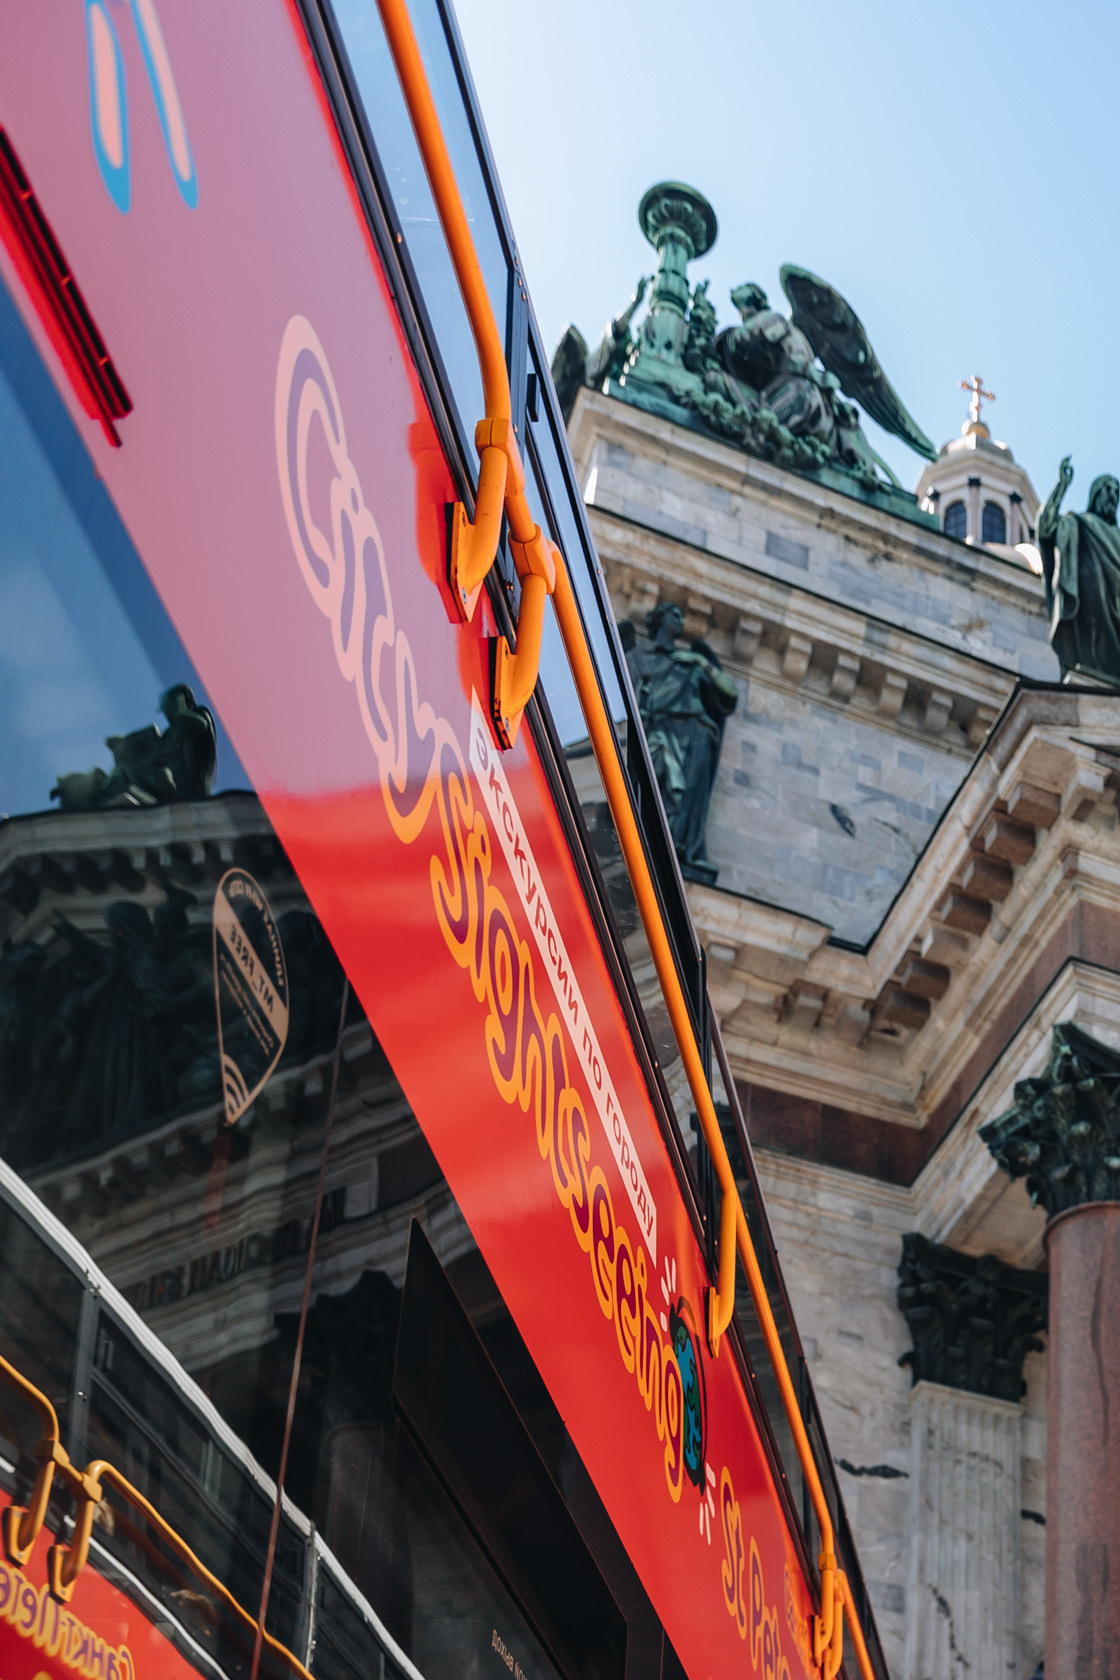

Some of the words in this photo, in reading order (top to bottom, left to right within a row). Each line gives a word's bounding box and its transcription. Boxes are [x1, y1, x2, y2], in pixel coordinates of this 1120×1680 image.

[275, 315, 437, 843] City
[430, 717, 684, 1503] Sightseeing
[475, 733, 579, 1026] экскурсии
[581, 1026, 604, 1091] по
[605, 1099, 654, 1240] городу
[721, 1465, 747, 1640] St
